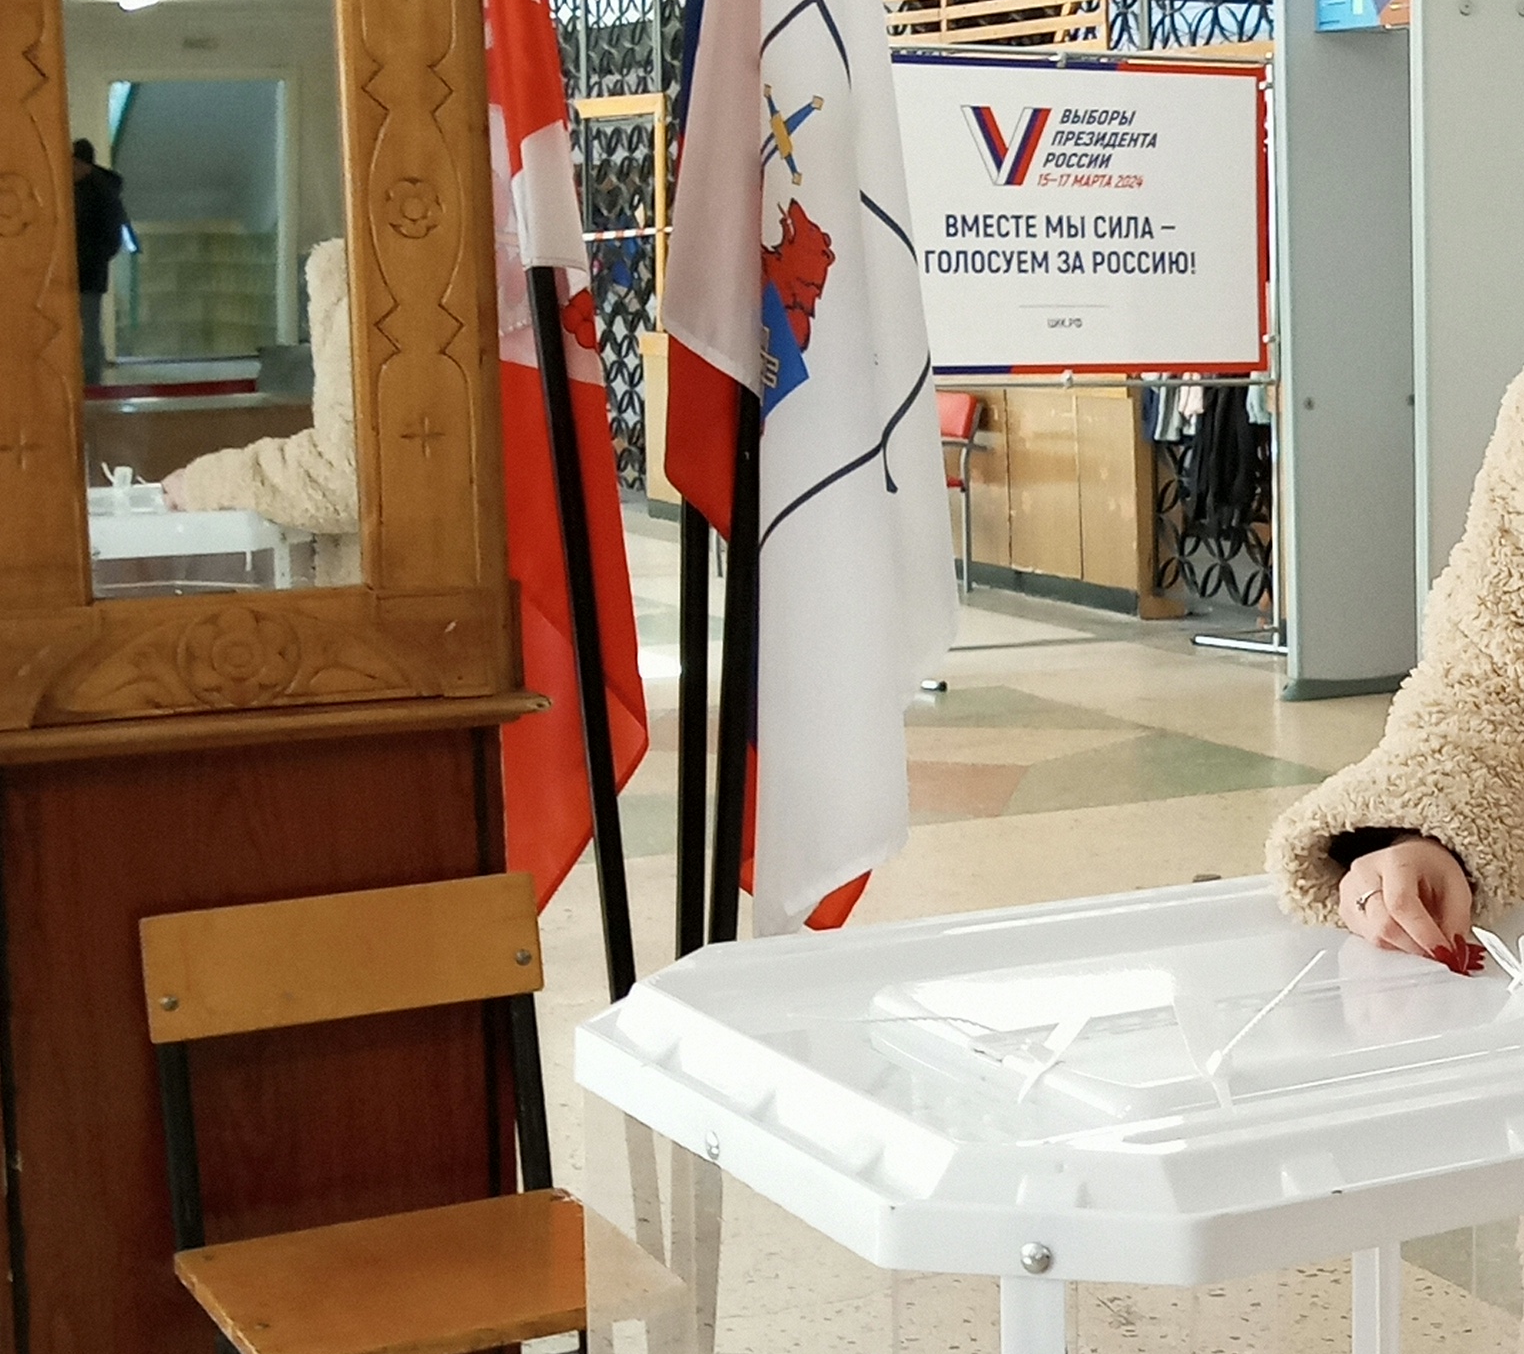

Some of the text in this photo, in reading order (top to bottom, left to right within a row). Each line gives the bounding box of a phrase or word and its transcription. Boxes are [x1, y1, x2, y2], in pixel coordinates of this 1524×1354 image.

[1059, 108, 1137, 127] ВЫБОРЫ
[1050, 130, 1159, 150] ПРЕЗИДЕНТА
[1042, 152, 1113, 169] РОССИИ
[1073, 174, 1113, 188] МАРТА
[1114, 174, 1145, 189] 2024
[944, 214, 1038, 239] ВМЕСТЕ
[1044, 215, 1086, 239] МЫ
[1093, 215, 1155, 240] СИЛА
[923, 250, 1197, 275] ГОЛОСУЕМ ЗА РОССИЮ!
